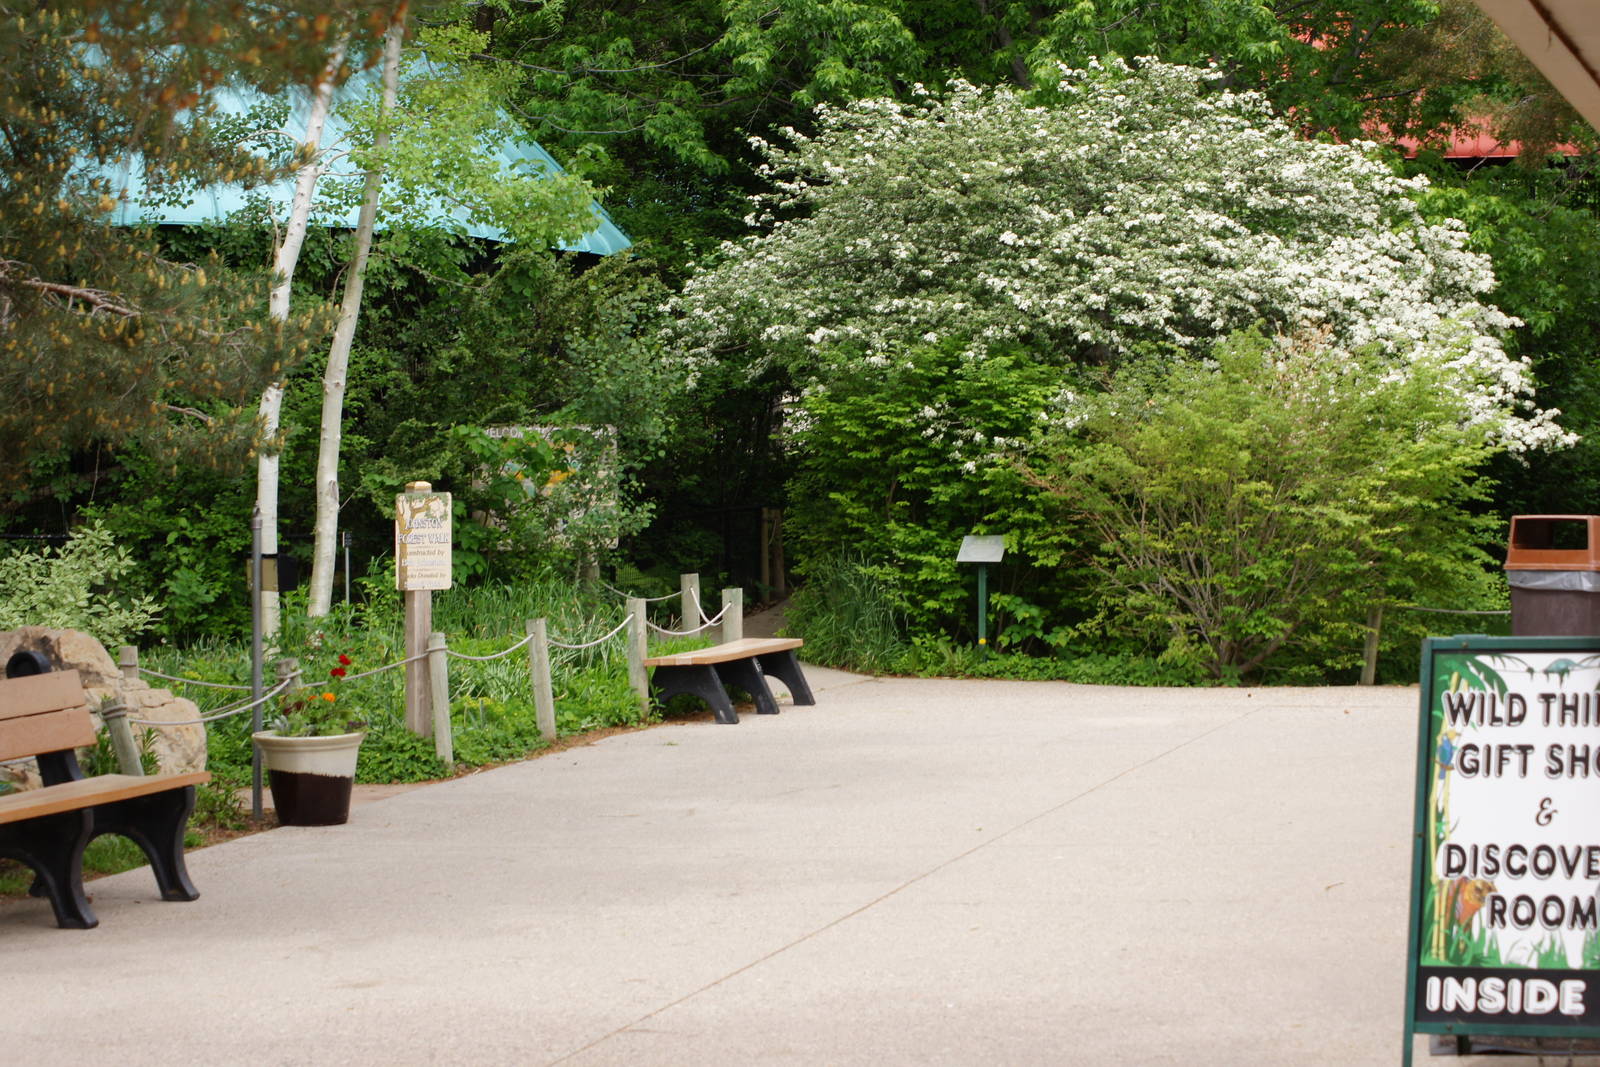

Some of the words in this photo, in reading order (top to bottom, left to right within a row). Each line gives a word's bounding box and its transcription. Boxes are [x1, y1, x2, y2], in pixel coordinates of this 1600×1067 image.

[1442, 691, 1527, 727] WILD
[1456, 743, 1534, 779] GIFT
[1536, 797, 1558, 827] &
[1442, 843, 1600, 880] DISCOVE
[1486, 894, 1598, 931] ROOM
[1426, 976, 1586, 1015] INSIDE
